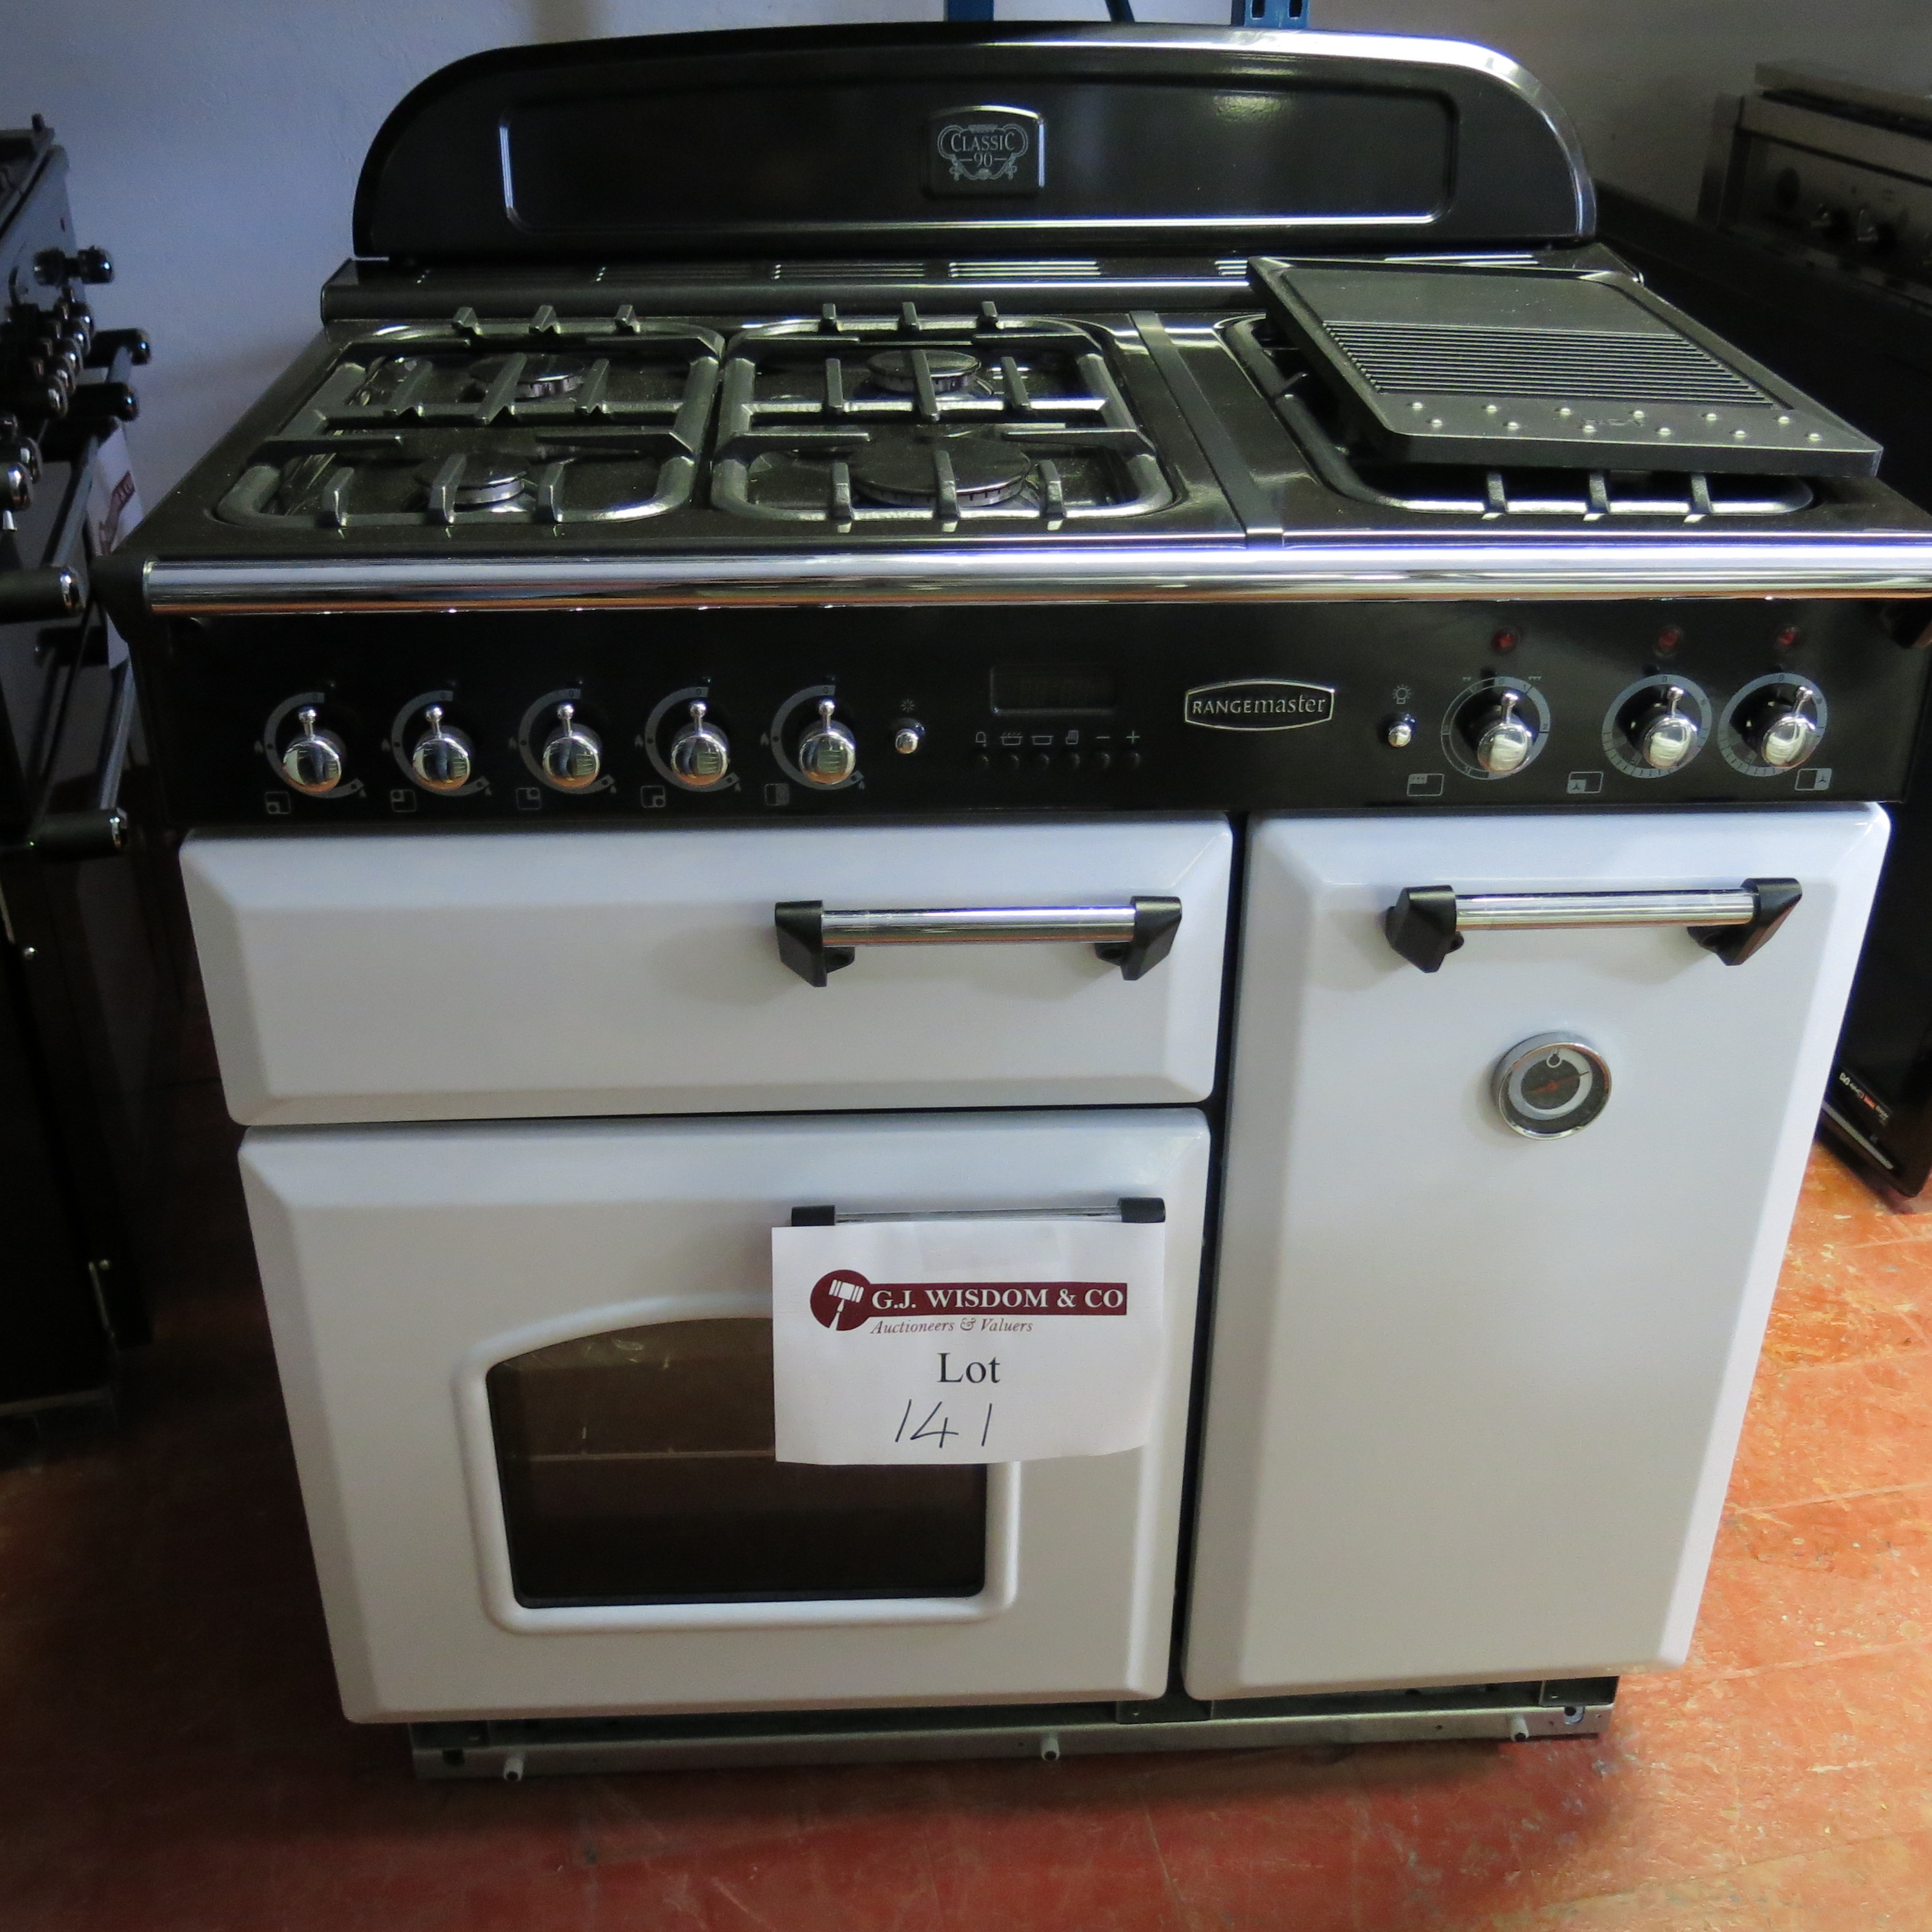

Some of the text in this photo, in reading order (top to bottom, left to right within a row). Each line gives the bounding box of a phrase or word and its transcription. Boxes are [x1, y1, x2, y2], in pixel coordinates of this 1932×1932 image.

[951, 132, 1015, 152] CLASSIC
[973, 152, 993, 168] 90
[1192, 694, 1326, 714] RANGEmaster
[871, 1288, 1124, 1310] G.J. WISDOM & CO
[870, 1318, 1033, 1335] Auctioneers & Valuers
[937, 1353, 1001, 1383] Lot
[895, 1399, 992, 1448] 141
